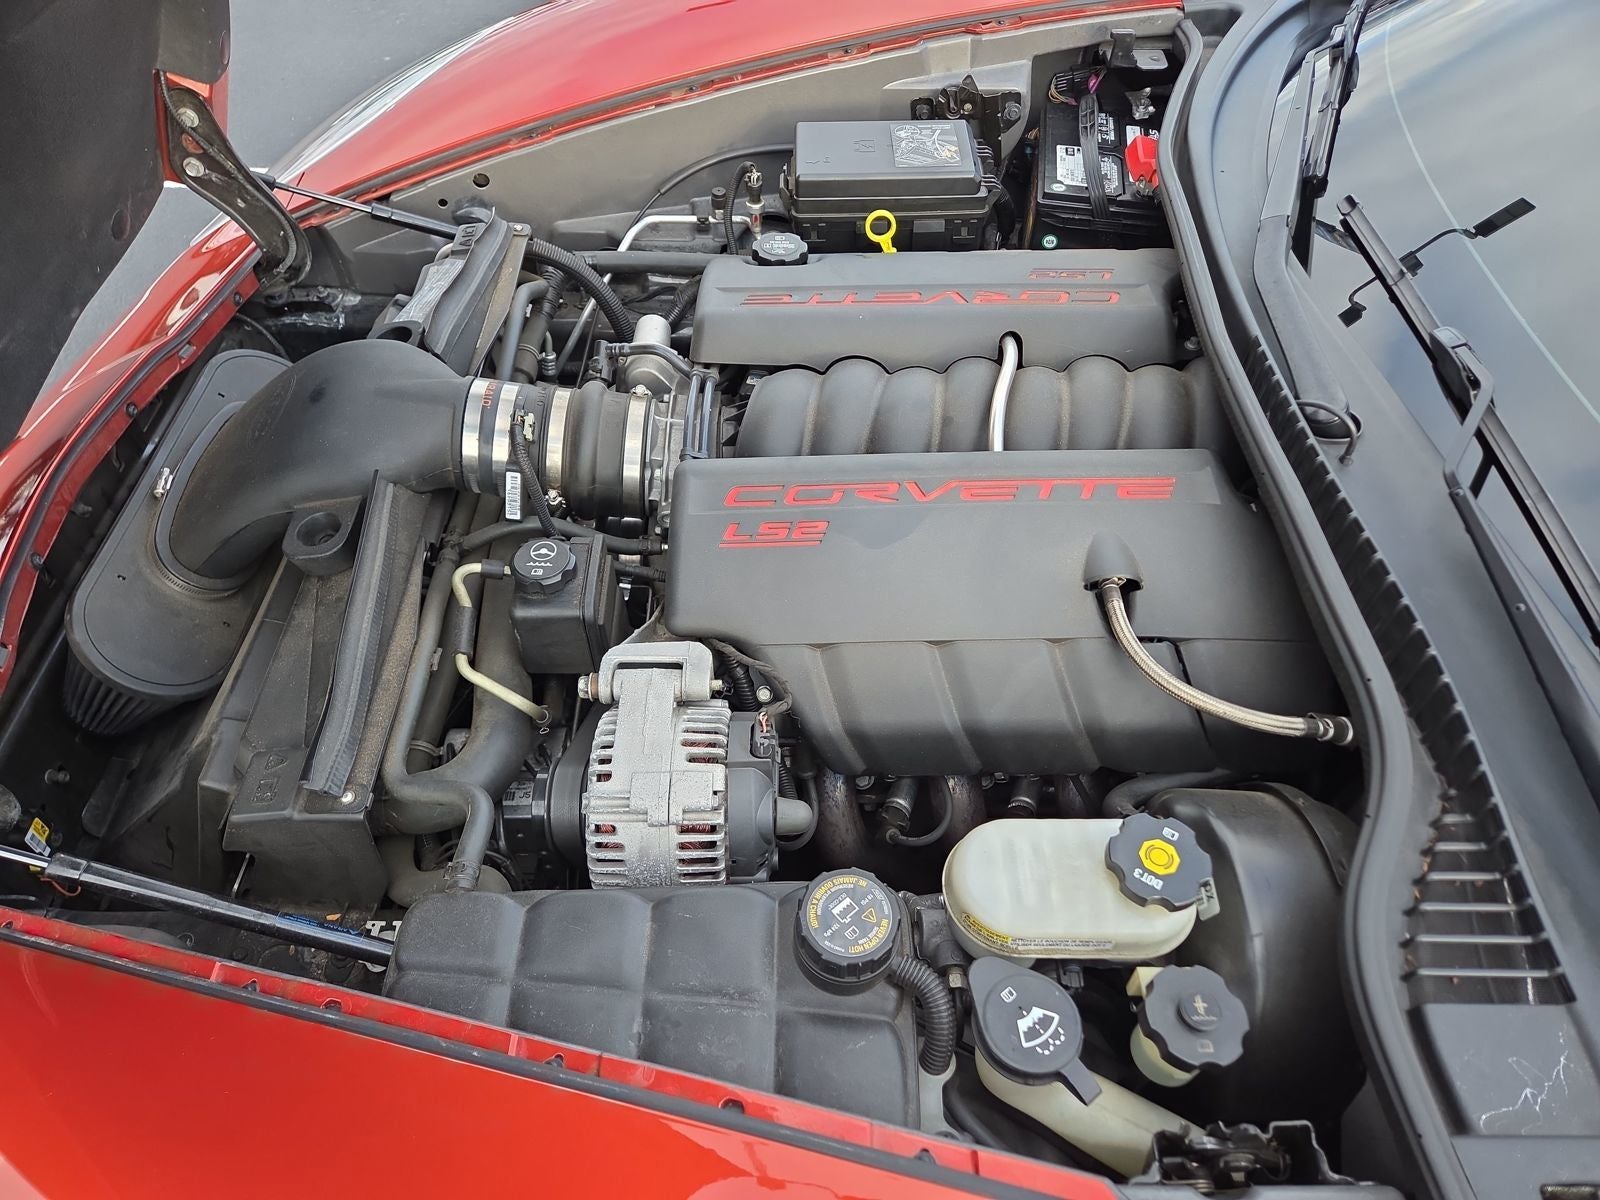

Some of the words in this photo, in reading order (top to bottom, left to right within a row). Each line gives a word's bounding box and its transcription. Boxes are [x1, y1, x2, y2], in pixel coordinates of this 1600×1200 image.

[1028, 267, 1115, 280] LS2
[740, 289, 1121, 306] CORVETTE
[722, 476, 1177, 508] CORVETTE
[721, 520, 830, 544] LS2
[813, 880, 833, 899] OUVRIR
[832, 876, 857, 886] JAMAIS
[875, 918, 888, 938] NEVER
[848, 943, 864, 953] HOT!
[862, 935, 879, 949] OPEN
